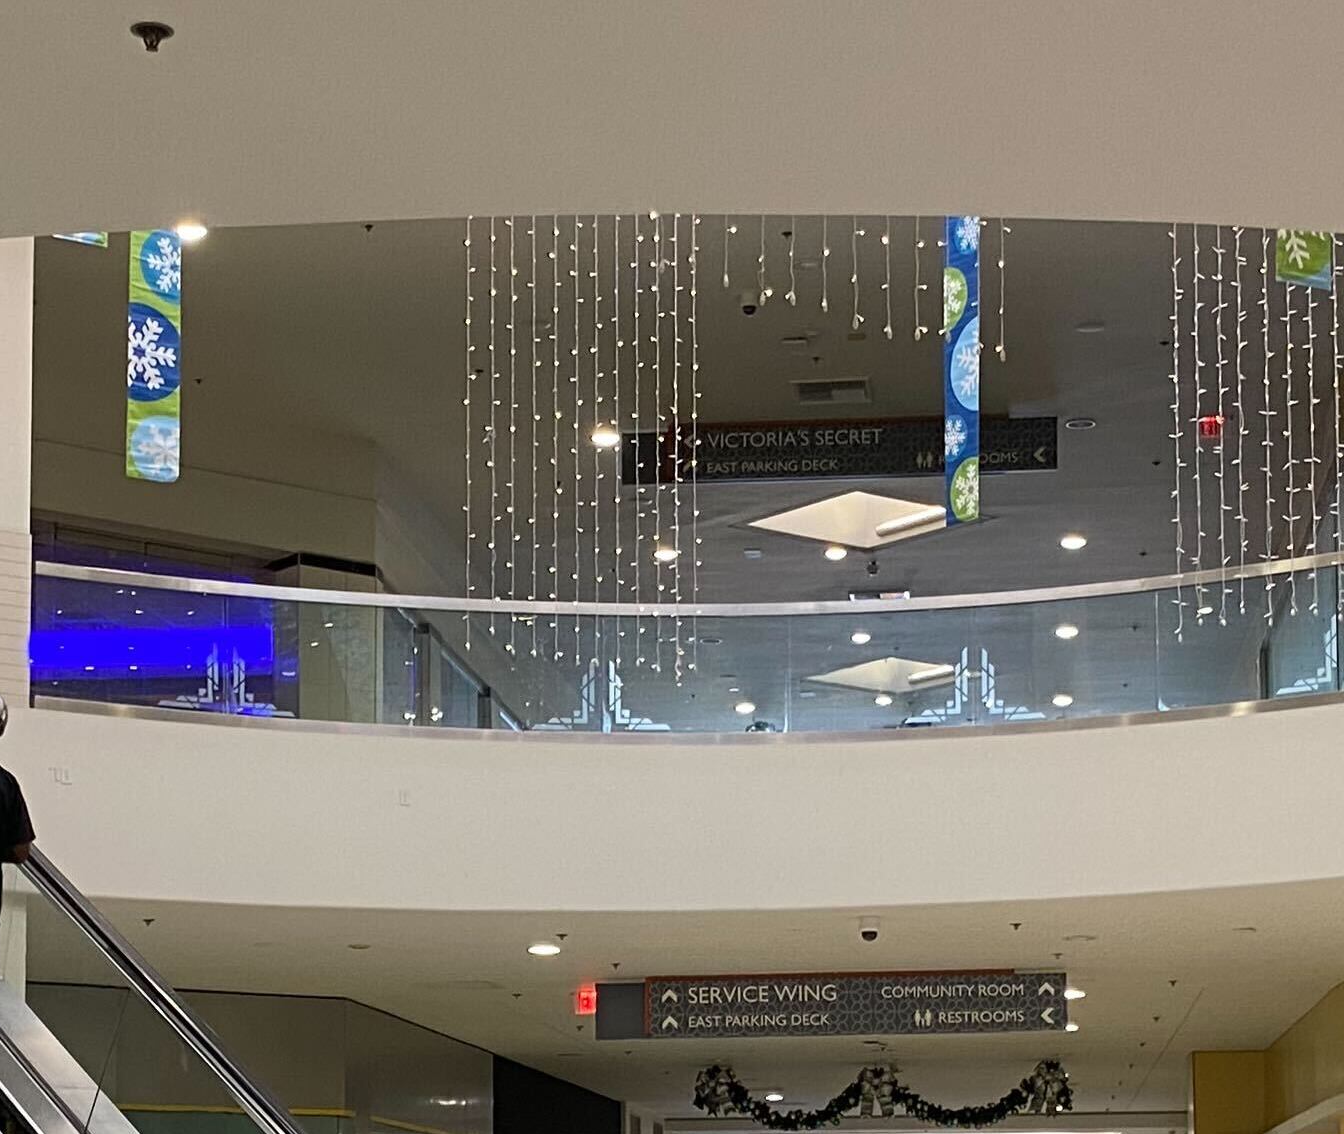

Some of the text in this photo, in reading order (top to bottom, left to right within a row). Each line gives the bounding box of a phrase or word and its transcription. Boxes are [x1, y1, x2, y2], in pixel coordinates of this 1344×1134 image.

[707, 428, 883, 448] VICTORIA'S SECRET
[707, 459, 839, 474] EAST PARKING DECK
[688, 984, 838, 1004] SERVICE WING
[881, 983, 1024, 998] COMMUNITY ROOM
[688, 1013, 830, 1028] EAST PARKING DECK
[938, 1010, 1025, 1024] RESTROOMS
